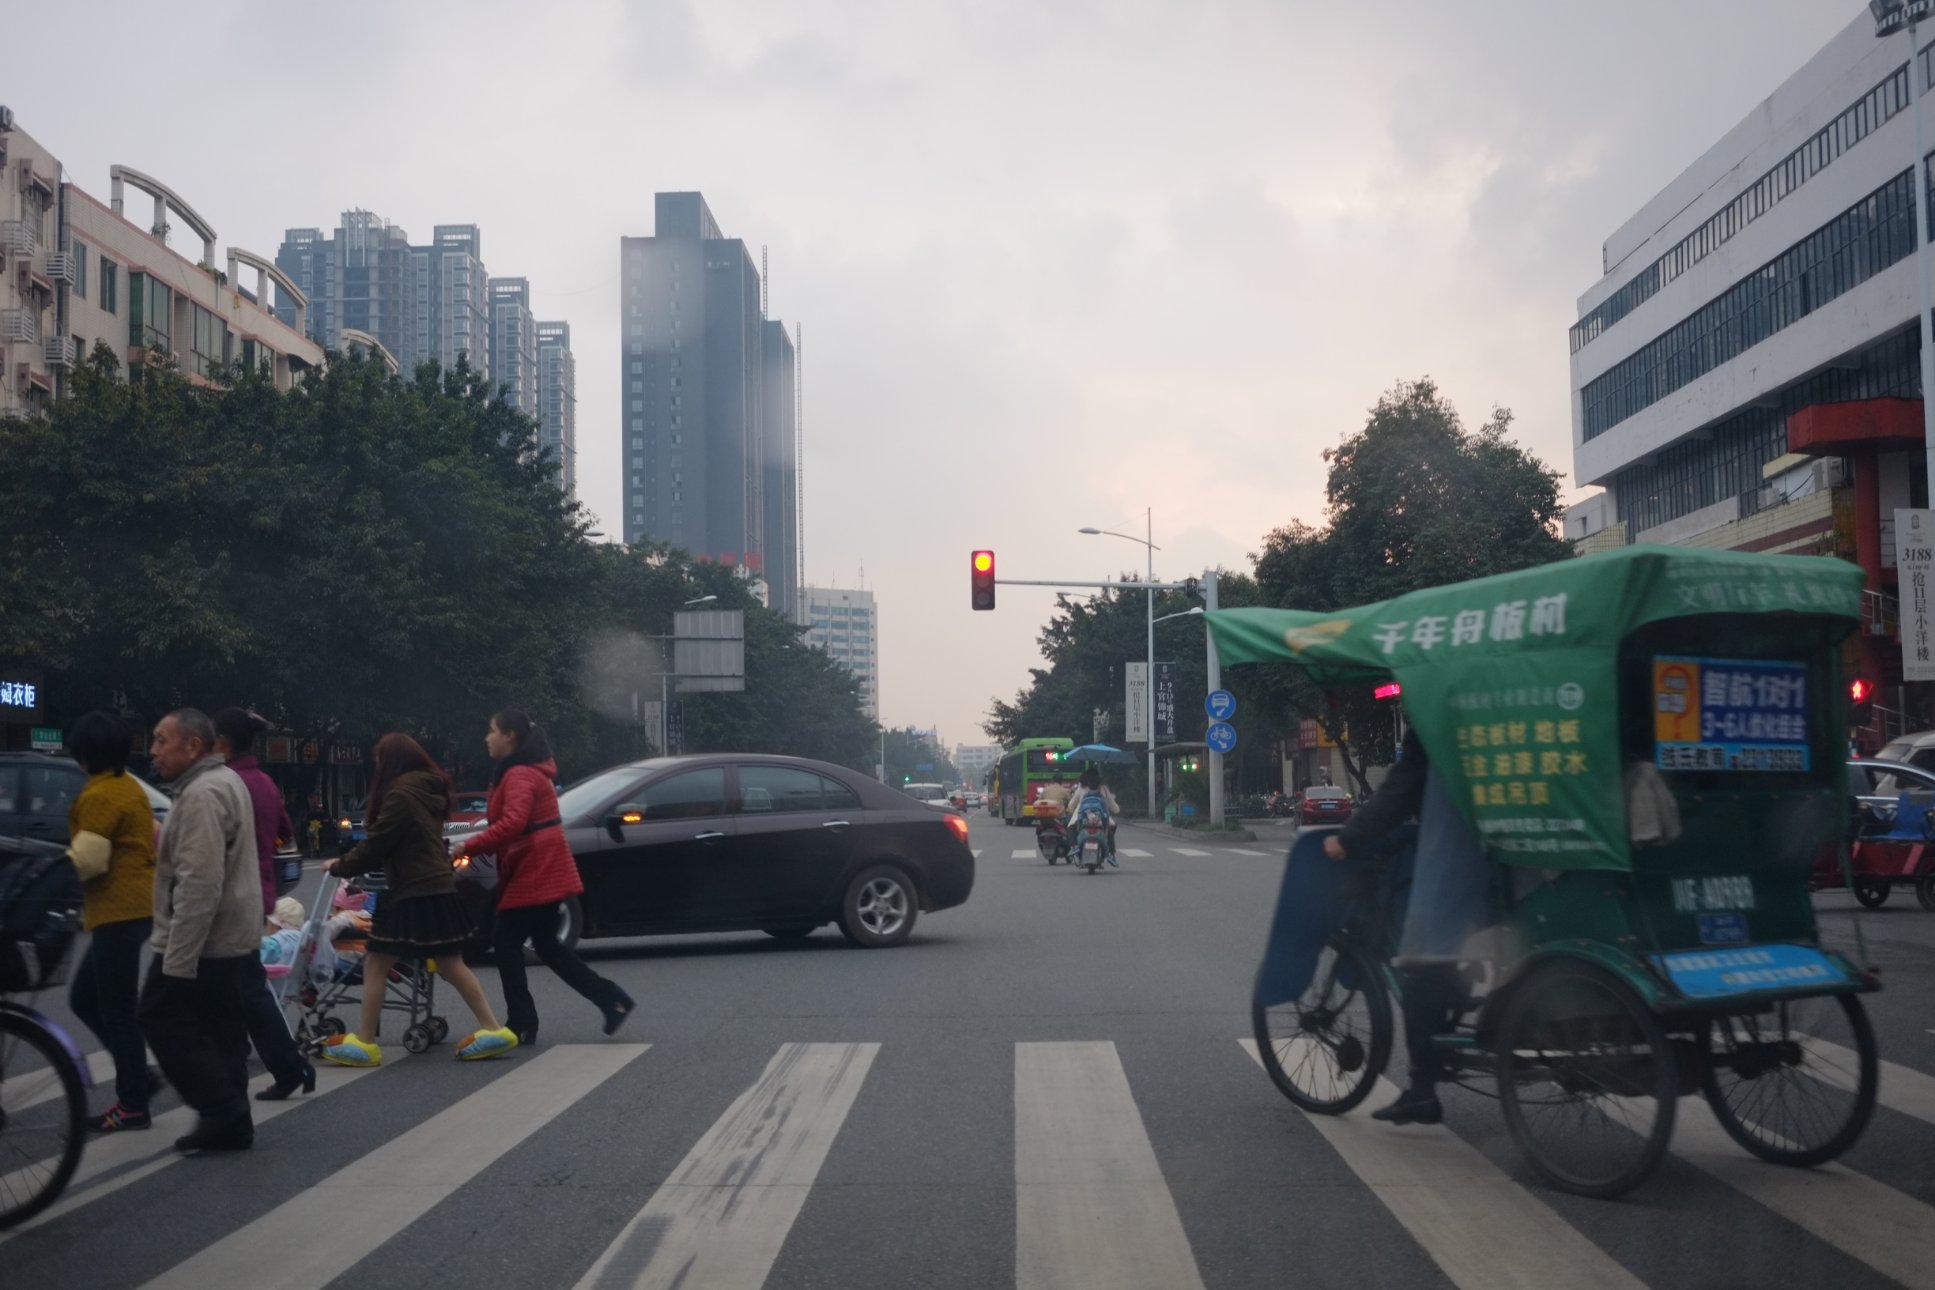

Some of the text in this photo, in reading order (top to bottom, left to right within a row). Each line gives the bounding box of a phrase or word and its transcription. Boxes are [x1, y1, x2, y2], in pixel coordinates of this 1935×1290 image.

[1902, 547, 1932, 562] 3188
[1371, 592, 1568, 655] 千年舟板材
